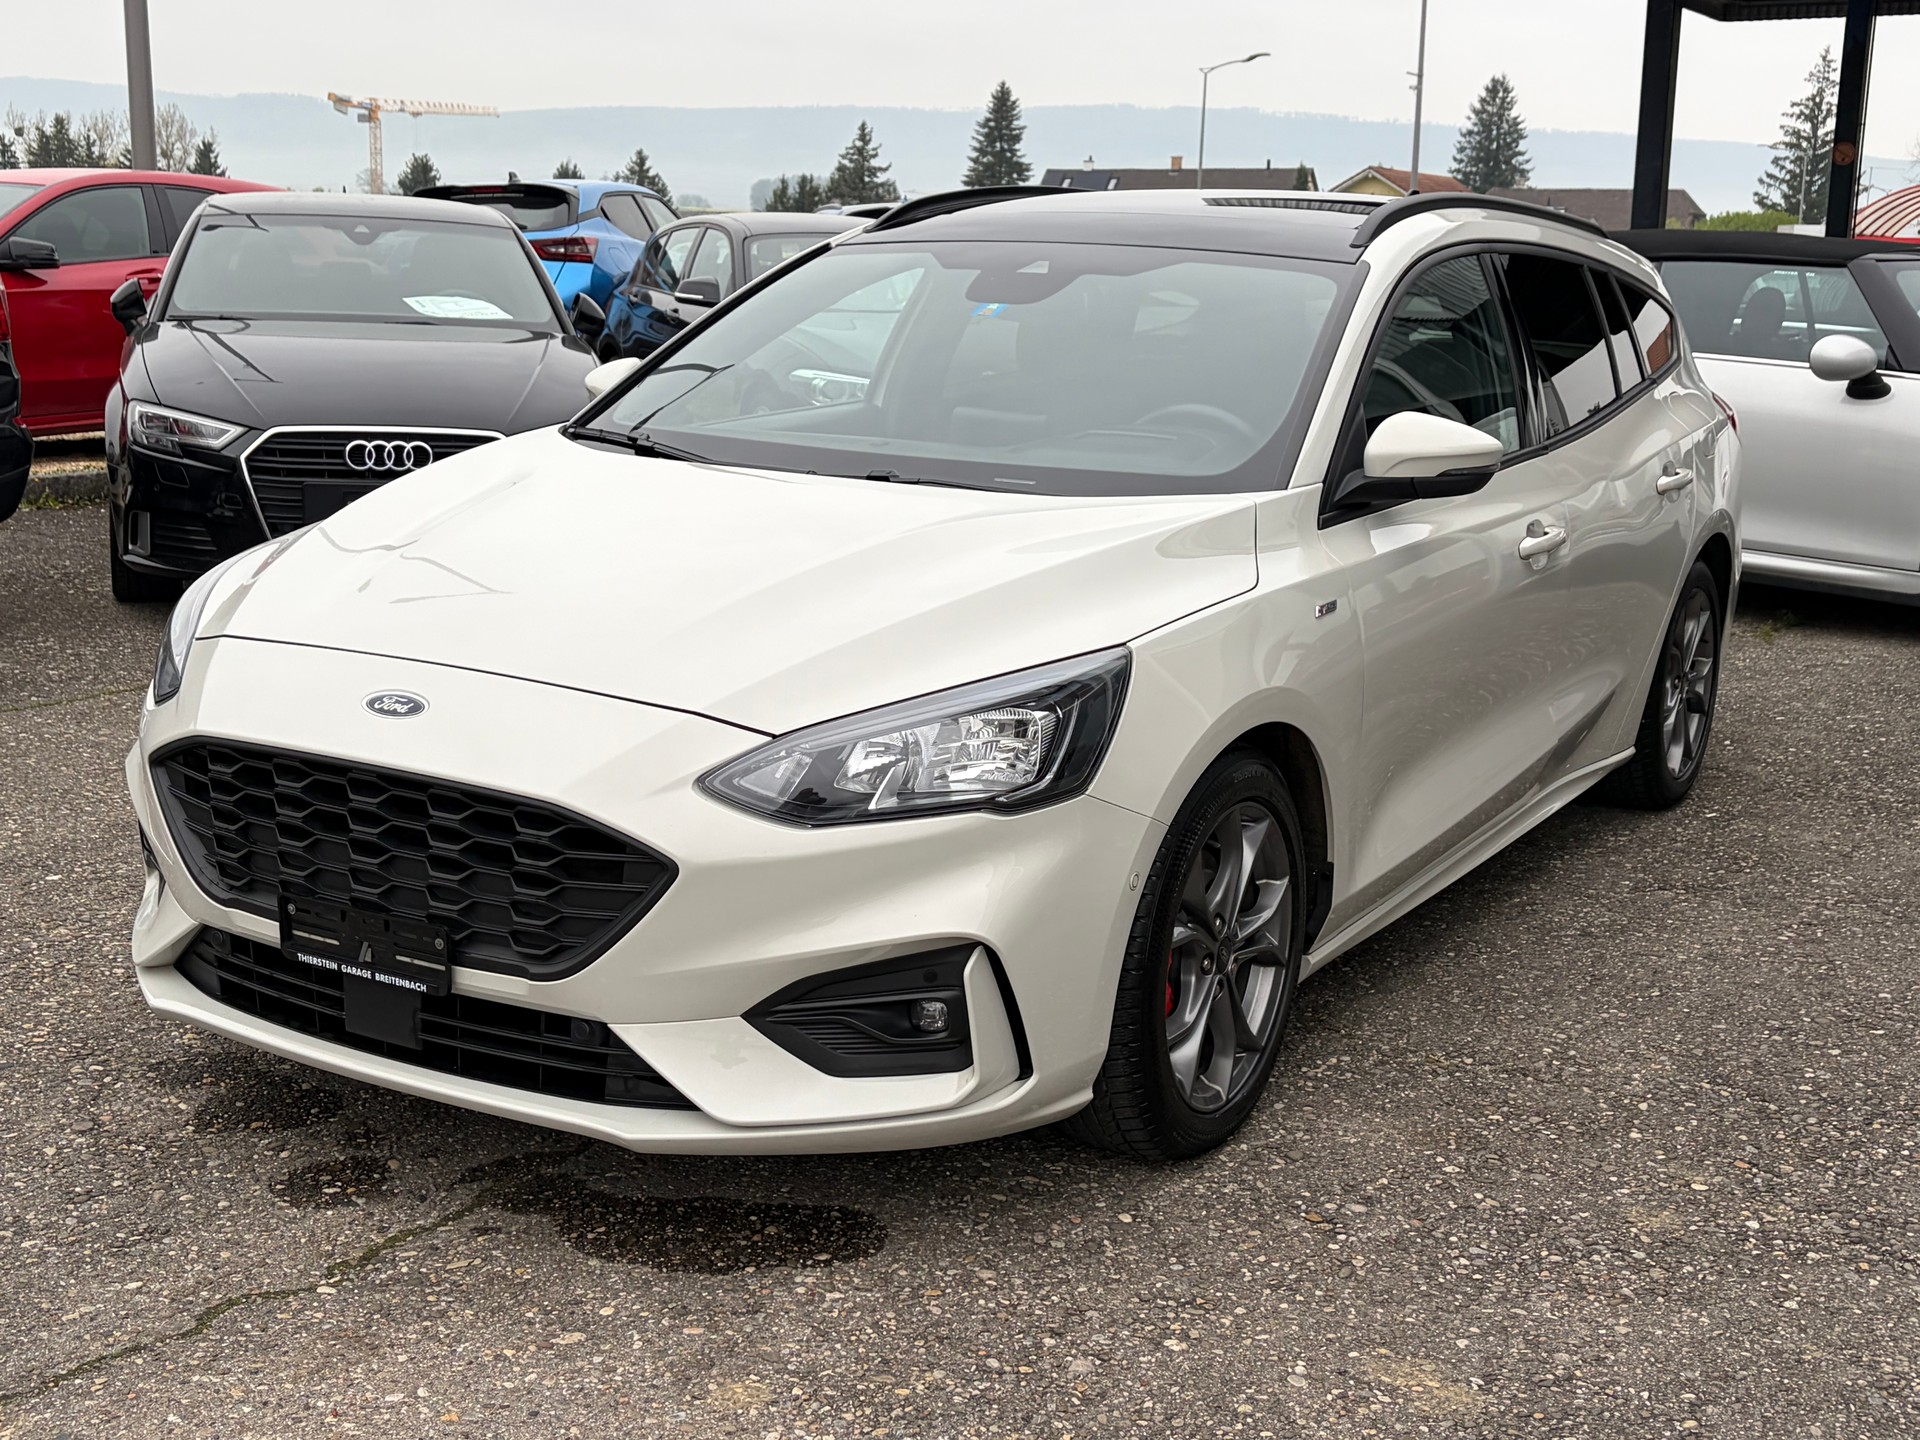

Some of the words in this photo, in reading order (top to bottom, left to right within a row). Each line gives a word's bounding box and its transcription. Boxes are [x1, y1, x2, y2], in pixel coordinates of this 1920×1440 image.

[374, 696, 414, 713] Ford
[297, 953, 338, 971] THIERSTEIN
[341, 964, 372, 980] GARAGE
[375, 972, 427, 993] BREITENBACH
